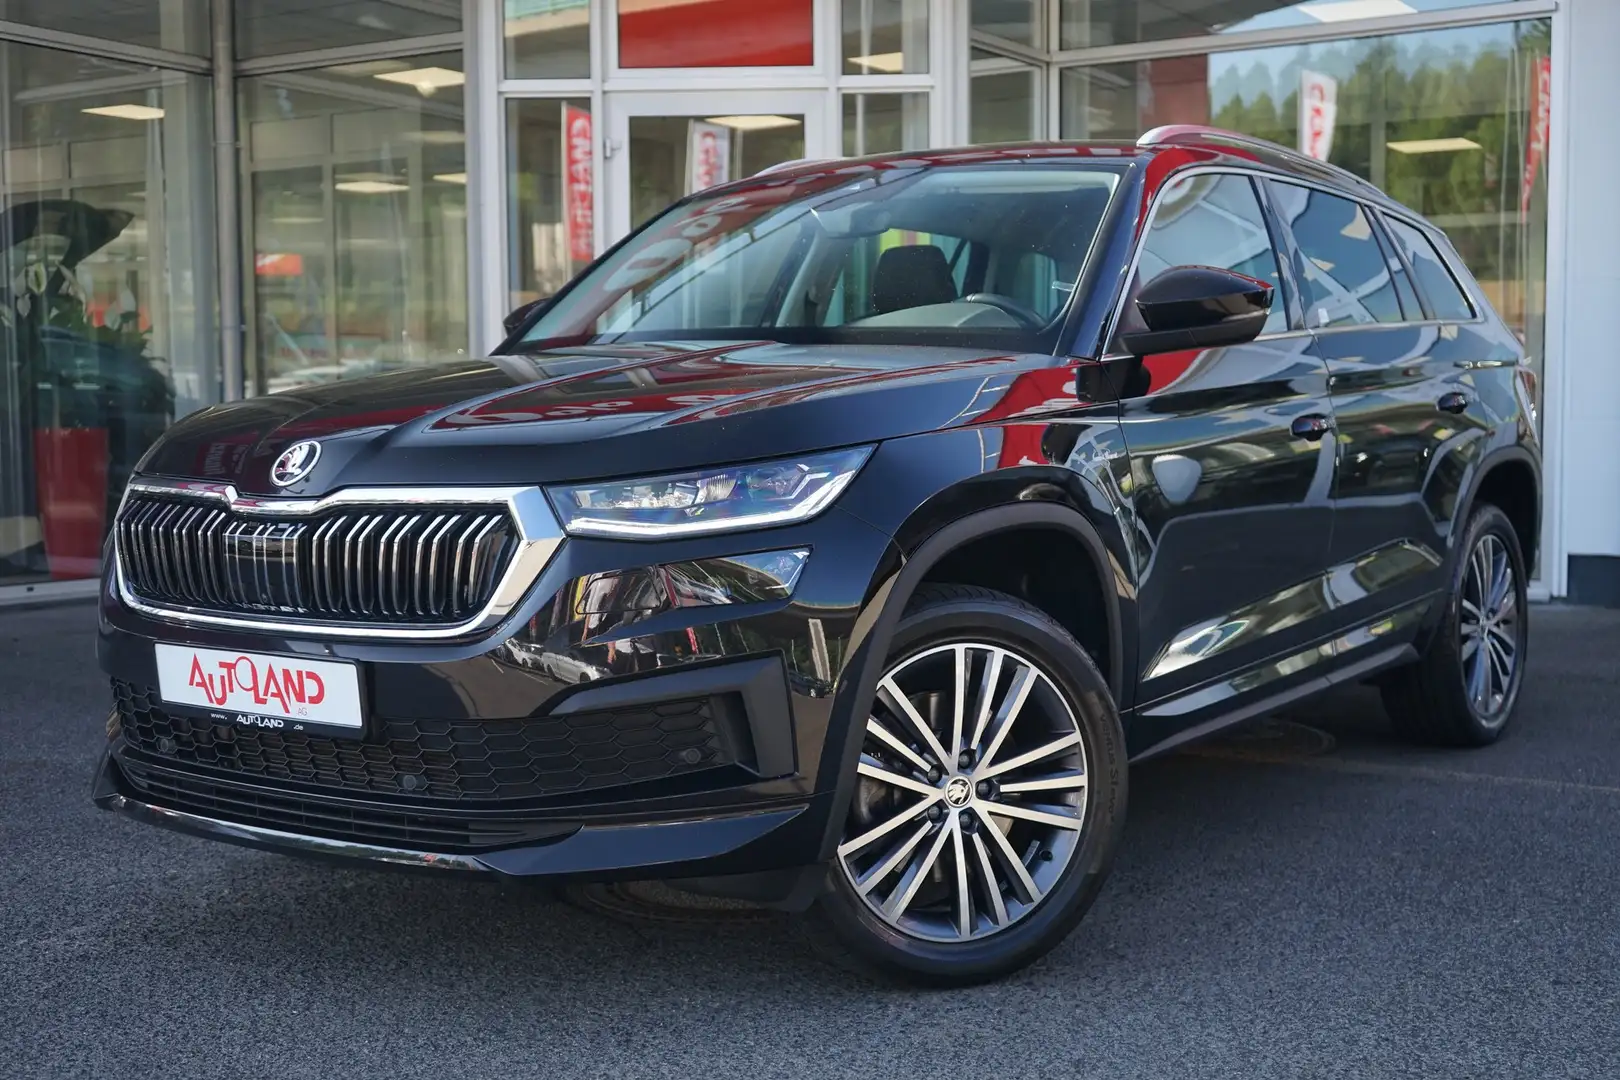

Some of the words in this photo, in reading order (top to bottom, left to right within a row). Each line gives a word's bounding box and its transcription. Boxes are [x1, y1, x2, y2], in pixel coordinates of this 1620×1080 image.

[188, 652, 325, 713] AUTOLAND
[297, 707, 308, 716] AG
[236, 714, 284, 728] AUTOLAND
